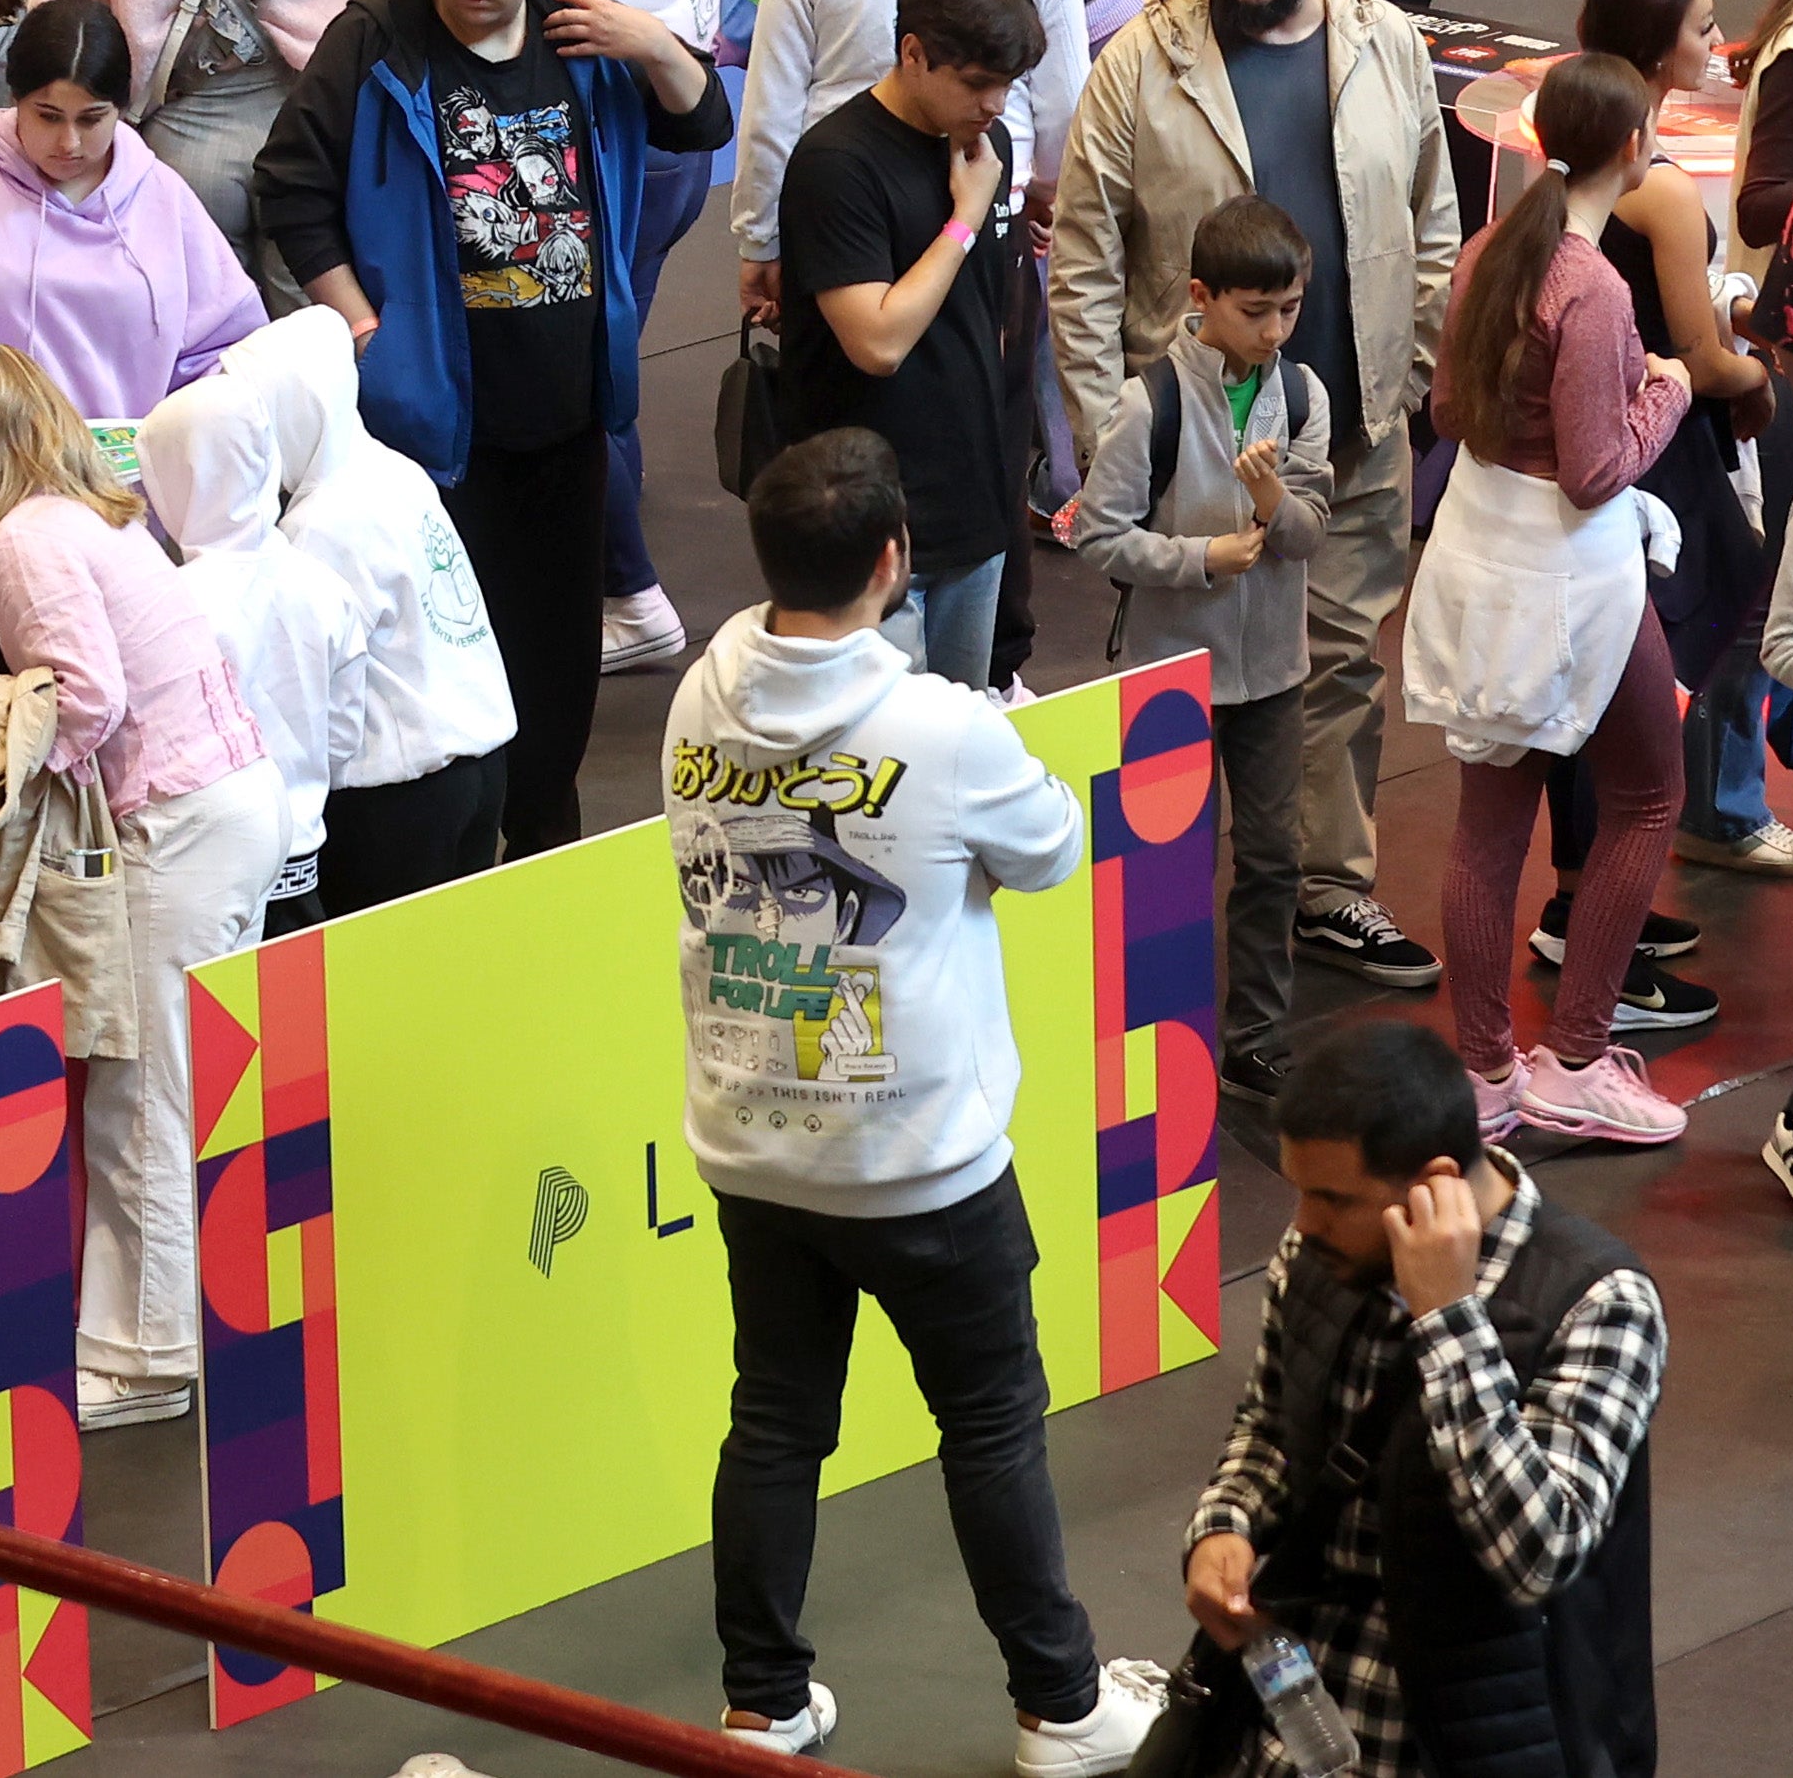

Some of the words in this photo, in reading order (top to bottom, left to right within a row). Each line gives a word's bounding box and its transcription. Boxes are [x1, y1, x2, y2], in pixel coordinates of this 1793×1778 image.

[424, 609, 455, 648] PUERTA
[454, 624, 490, 649] VERDE
[706, 933, 842, 988] TROLL
[709, 974, 766, 1013] FOR
[763, 986, 836, 1021] LIFE
[772, 1086, 809, 1101] THIS
[815, 1090, 857, 1104] ISN'T
[865, 1088, 908, 1104] REAL
